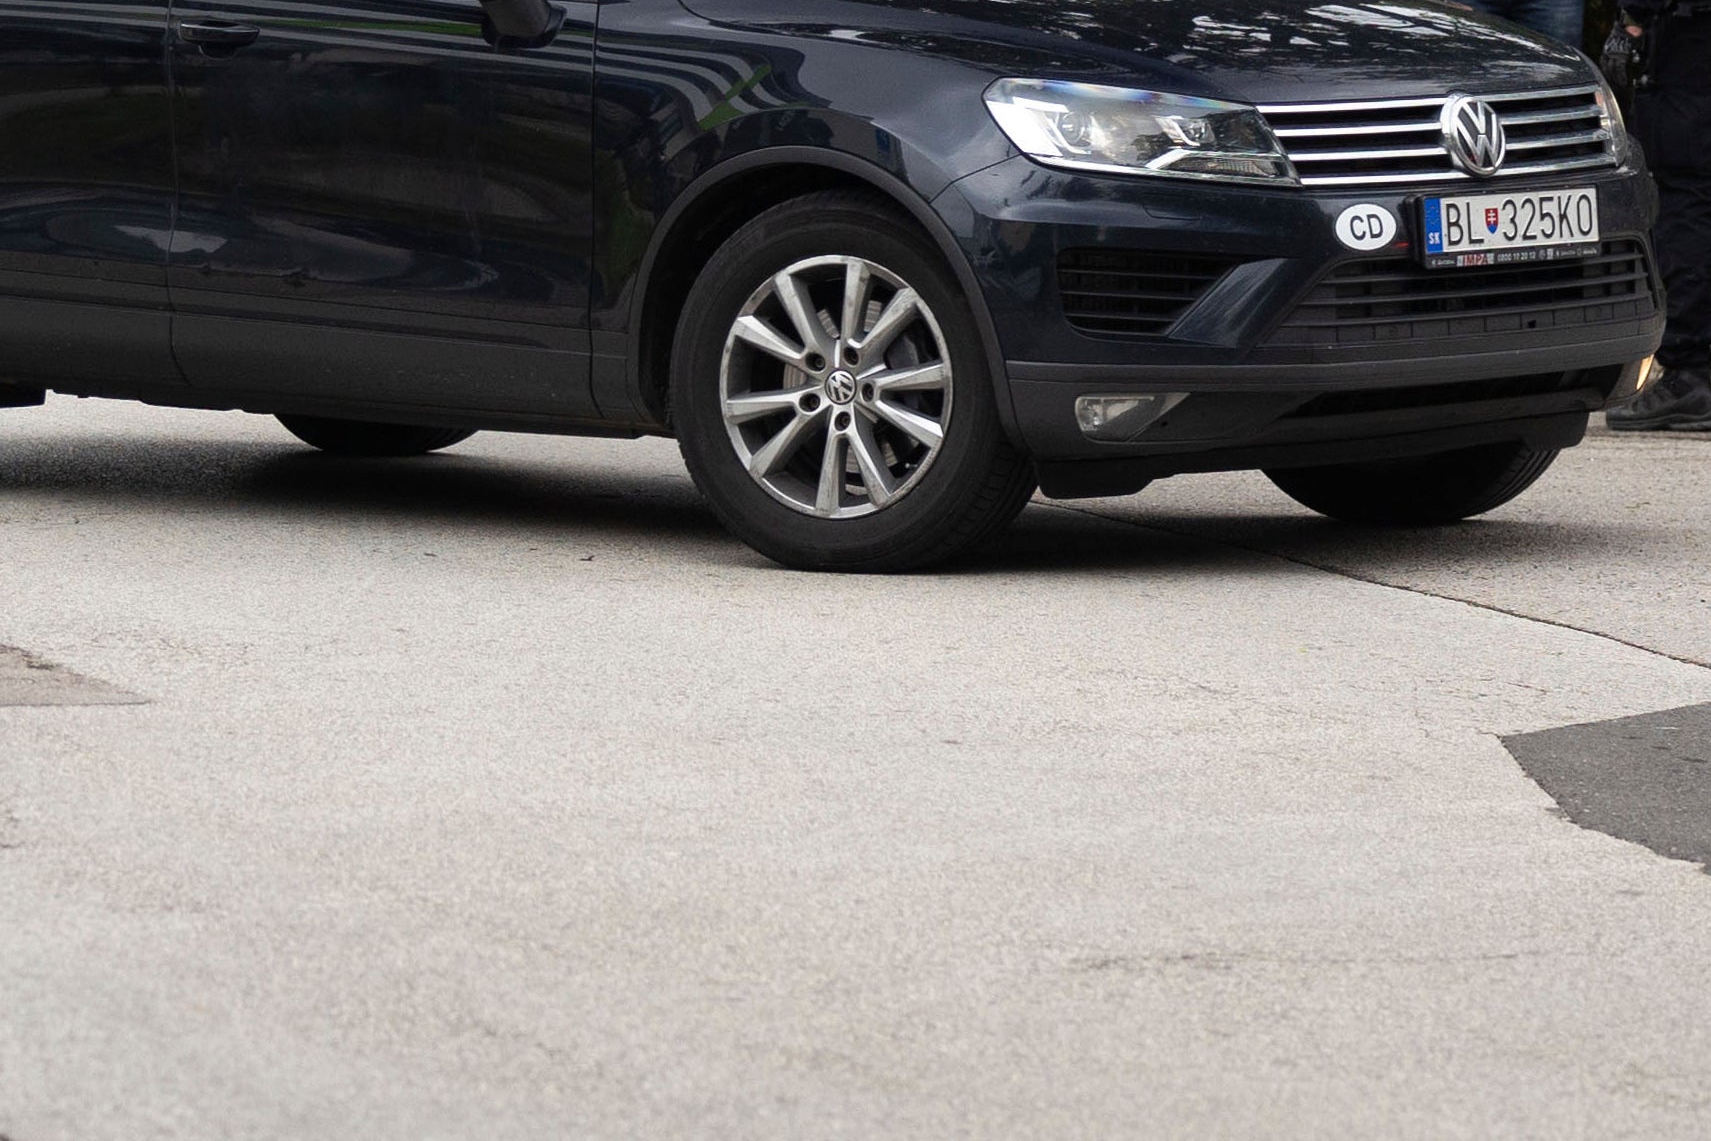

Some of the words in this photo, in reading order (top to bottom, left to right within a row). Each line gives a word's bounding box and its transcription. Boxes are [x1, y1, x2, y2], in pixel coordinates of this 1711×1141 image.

[1349, 213, 1384, 241] CD
[1445, 202, 1485, 246] BL
[1428, 232, 1441, 245] SK
